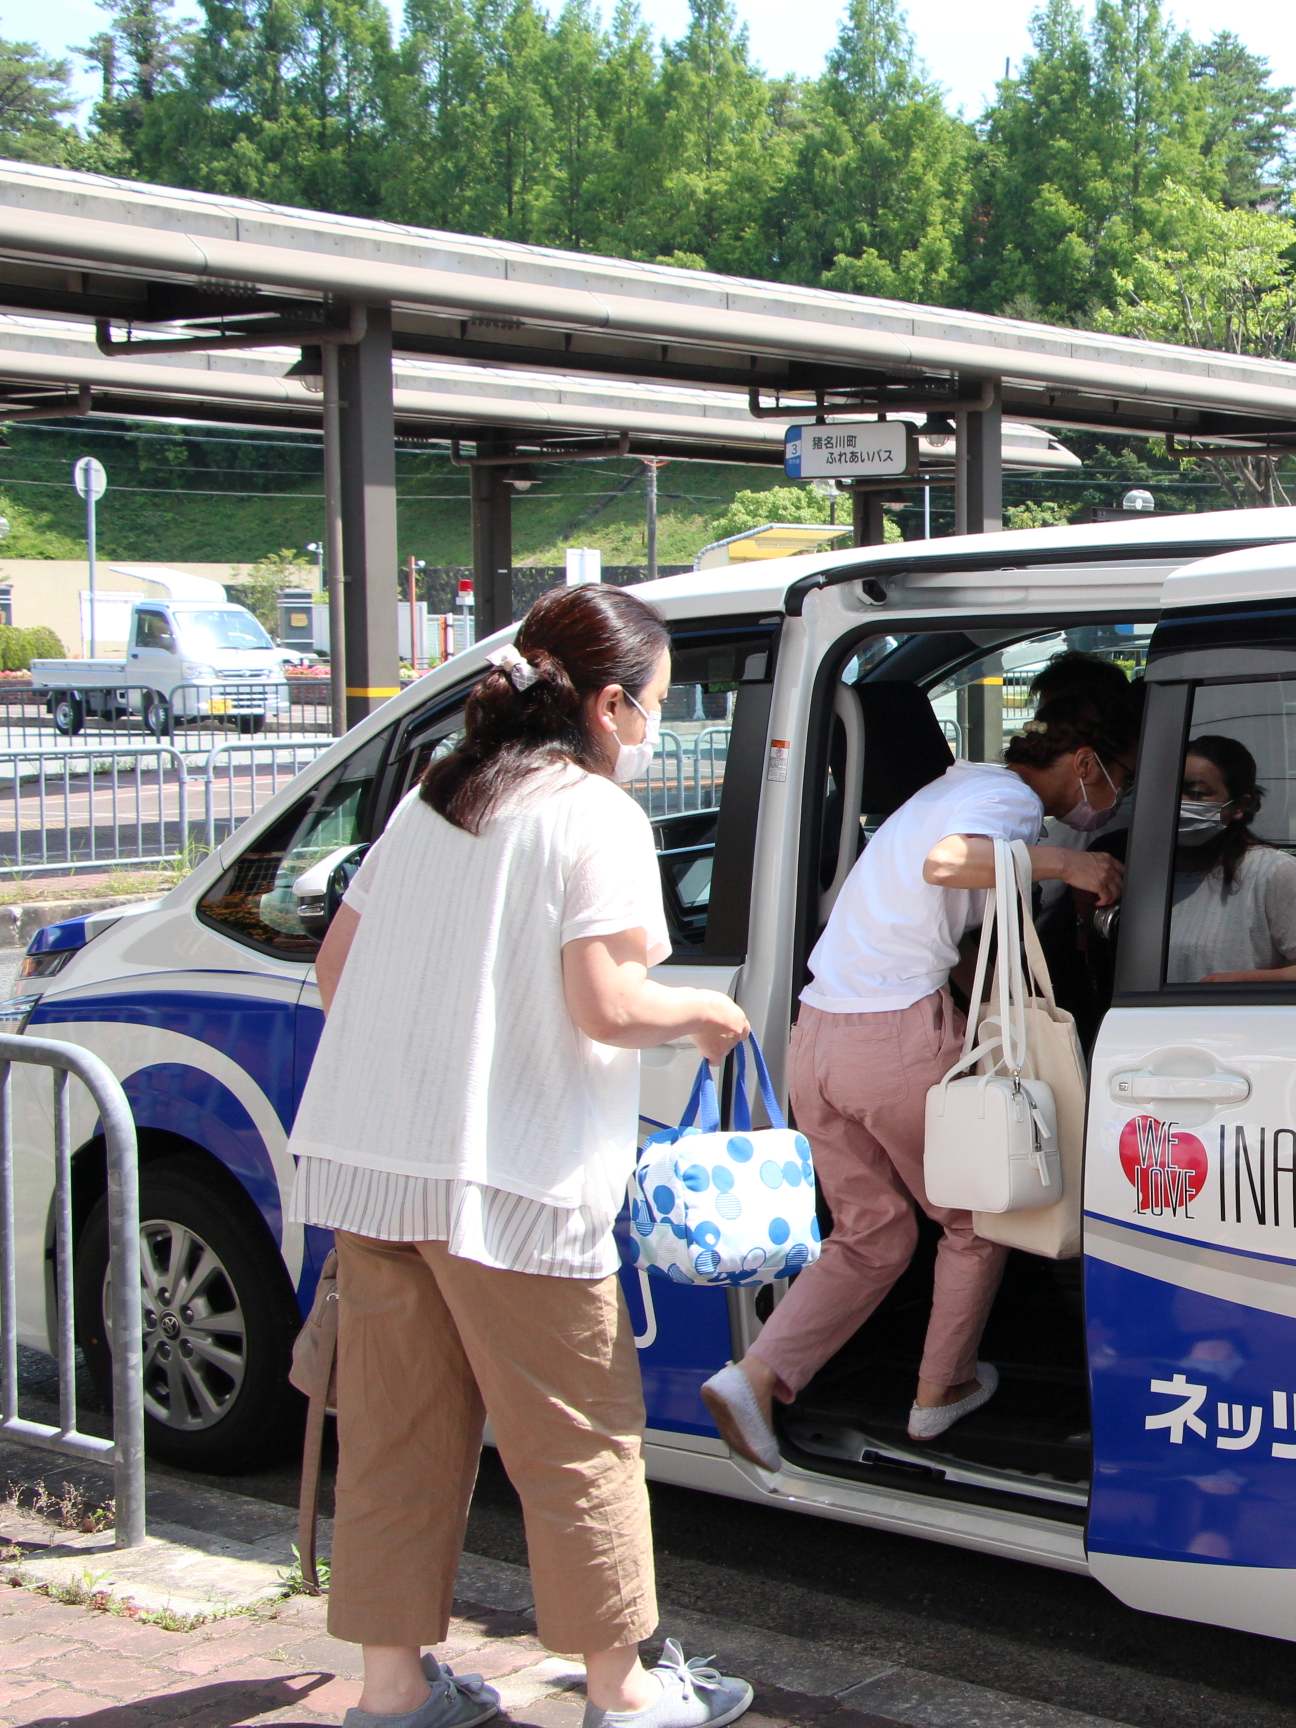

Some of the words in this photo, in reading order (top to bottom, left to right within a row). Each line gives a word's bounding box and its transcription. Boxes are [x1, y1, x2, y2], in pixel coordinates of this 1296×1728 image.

[791, 443, 798, 455] 3
[812, 434, 857, 450] 猪名川町
[826, 449, 893, 465] ふれあいバス
[1136, 1118, 1181, 1170] WE
[1135, 1166, 1196, 1220] LOVE
